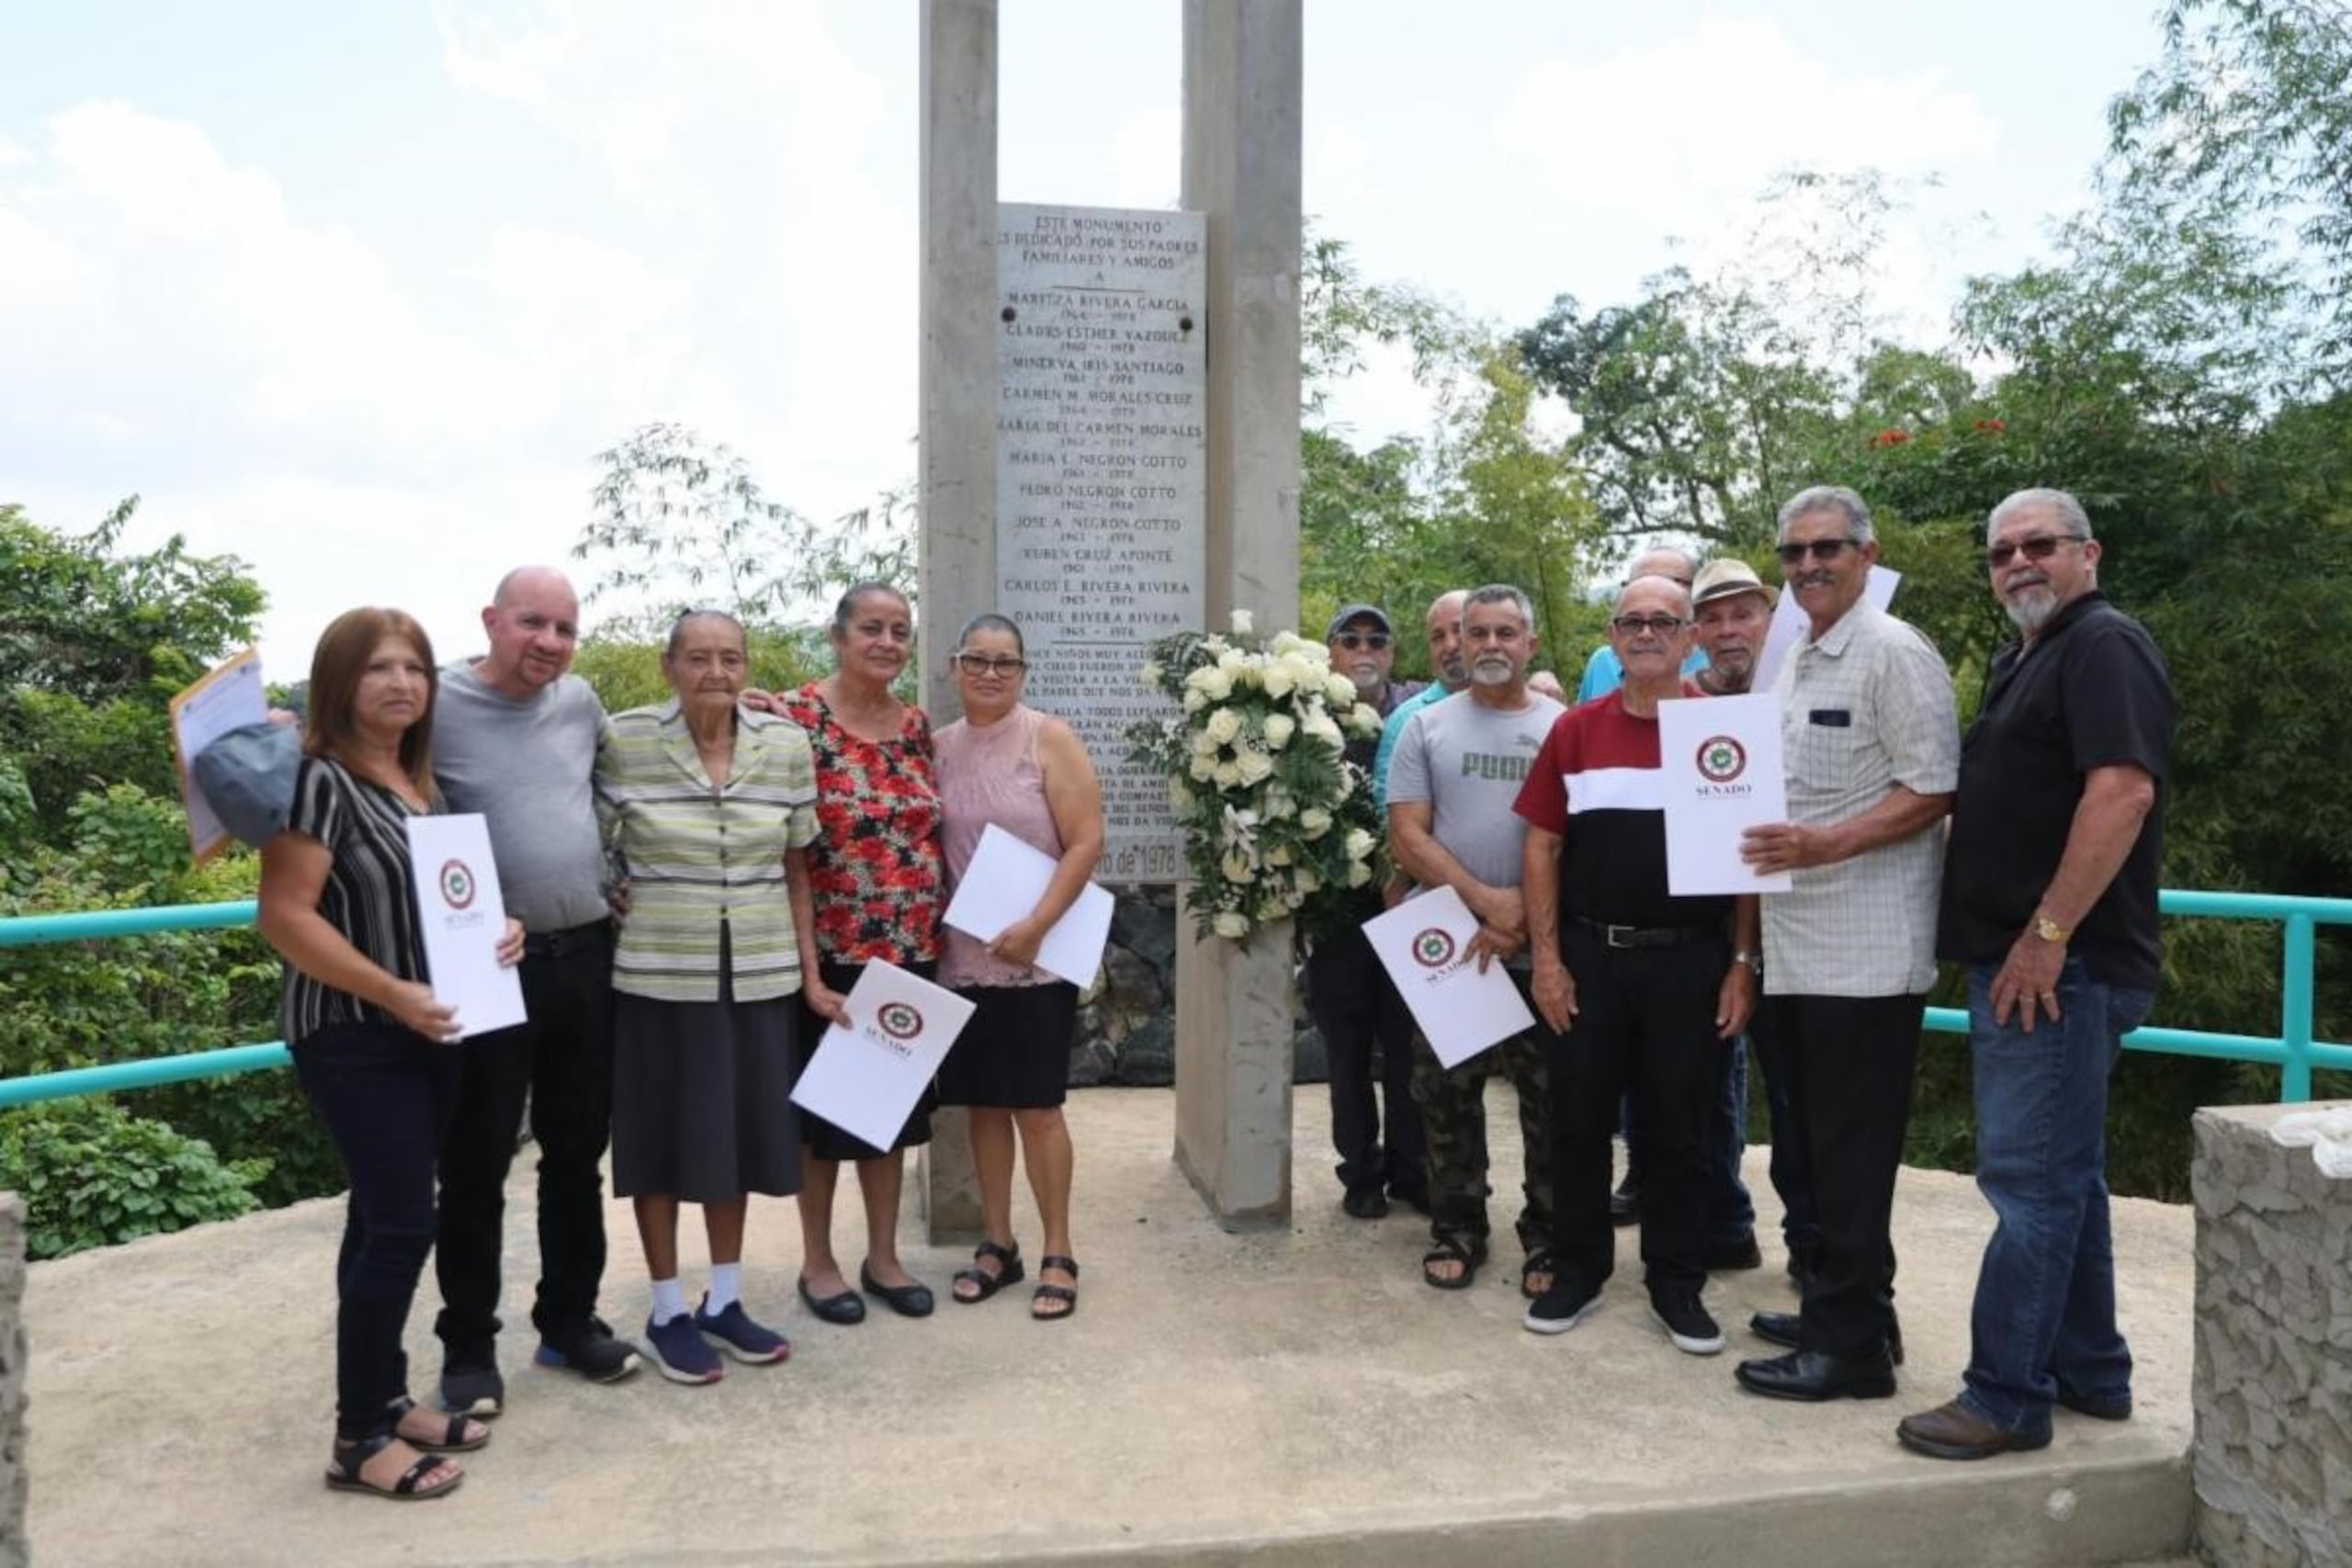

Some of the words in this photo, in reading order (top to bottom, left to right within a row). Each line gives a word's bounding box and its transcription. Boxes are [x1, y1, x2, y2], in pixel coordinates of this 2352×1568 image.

[1073, 218, 1162, 233] MONUMENTO
[1015, 233, 1082, 247] DEDICADO
[1091, 237, 1114, 248] POR
[1121, 238, 1145, 250] SUS
[1149, 240, 1198, 254] PADRES
[1023, 250, 1102, 265] FAMILIARES
[1108, 254, 1115, 265] Y
[1125, 256, 1175, 269] AMIGOS
[1080, 296, 1132, 310] RIVERA
[1067, 327, 1117, 340] ESTHER
[1012, 357, 1076, 370] MINERVA
[1114, 361, 1184, 376] SANTIAGO
[1002, 387, 1062, 400] CARMEN
[1089, 389, 1149, 404] MORALES
[1155, 393, 1193, 405] CRUZ
[1046, 421, 1069, 434] DEL
[1076, 423, 1134, 435] CARMEN
[1140, 424, 1202, 438] MORALES
[1010, 451, 1056, 465] MARIA
[1080, 454, 1136, 467] NEGRON
[1141, 455, 1187, 468] COTTO
[1020, 484, 1064, 497] PEDRO
[1069, 485, 1125, 498] NEGRON
[1131, 486, 1177, 500] COTTO
[1072, 517, 1129, 530] NEGRON
[1135, 518, 1182, 532] COTTO
[1075, 548, 1112, 561] CRUZ
[1120, 549, 1176, 563] APONTE
[1005, 579, 1058, 593] CARLOS
[1081, 580, 1132, 593] RIVERA
[1138, 581, 1190, 594] RIVERA
[1014, 611, 1065, 624] DANIEL
[1071, 612, 1122, 624] RIVERA
[1128, 612, 1181, 624] RIVERA
[1695, 784, 1752, 796] SENADO
[1116, 846, 1136, 875] de
[1140, 844, 1176, 875] 1978
[1426, 958, 1464, 983] SENAD
